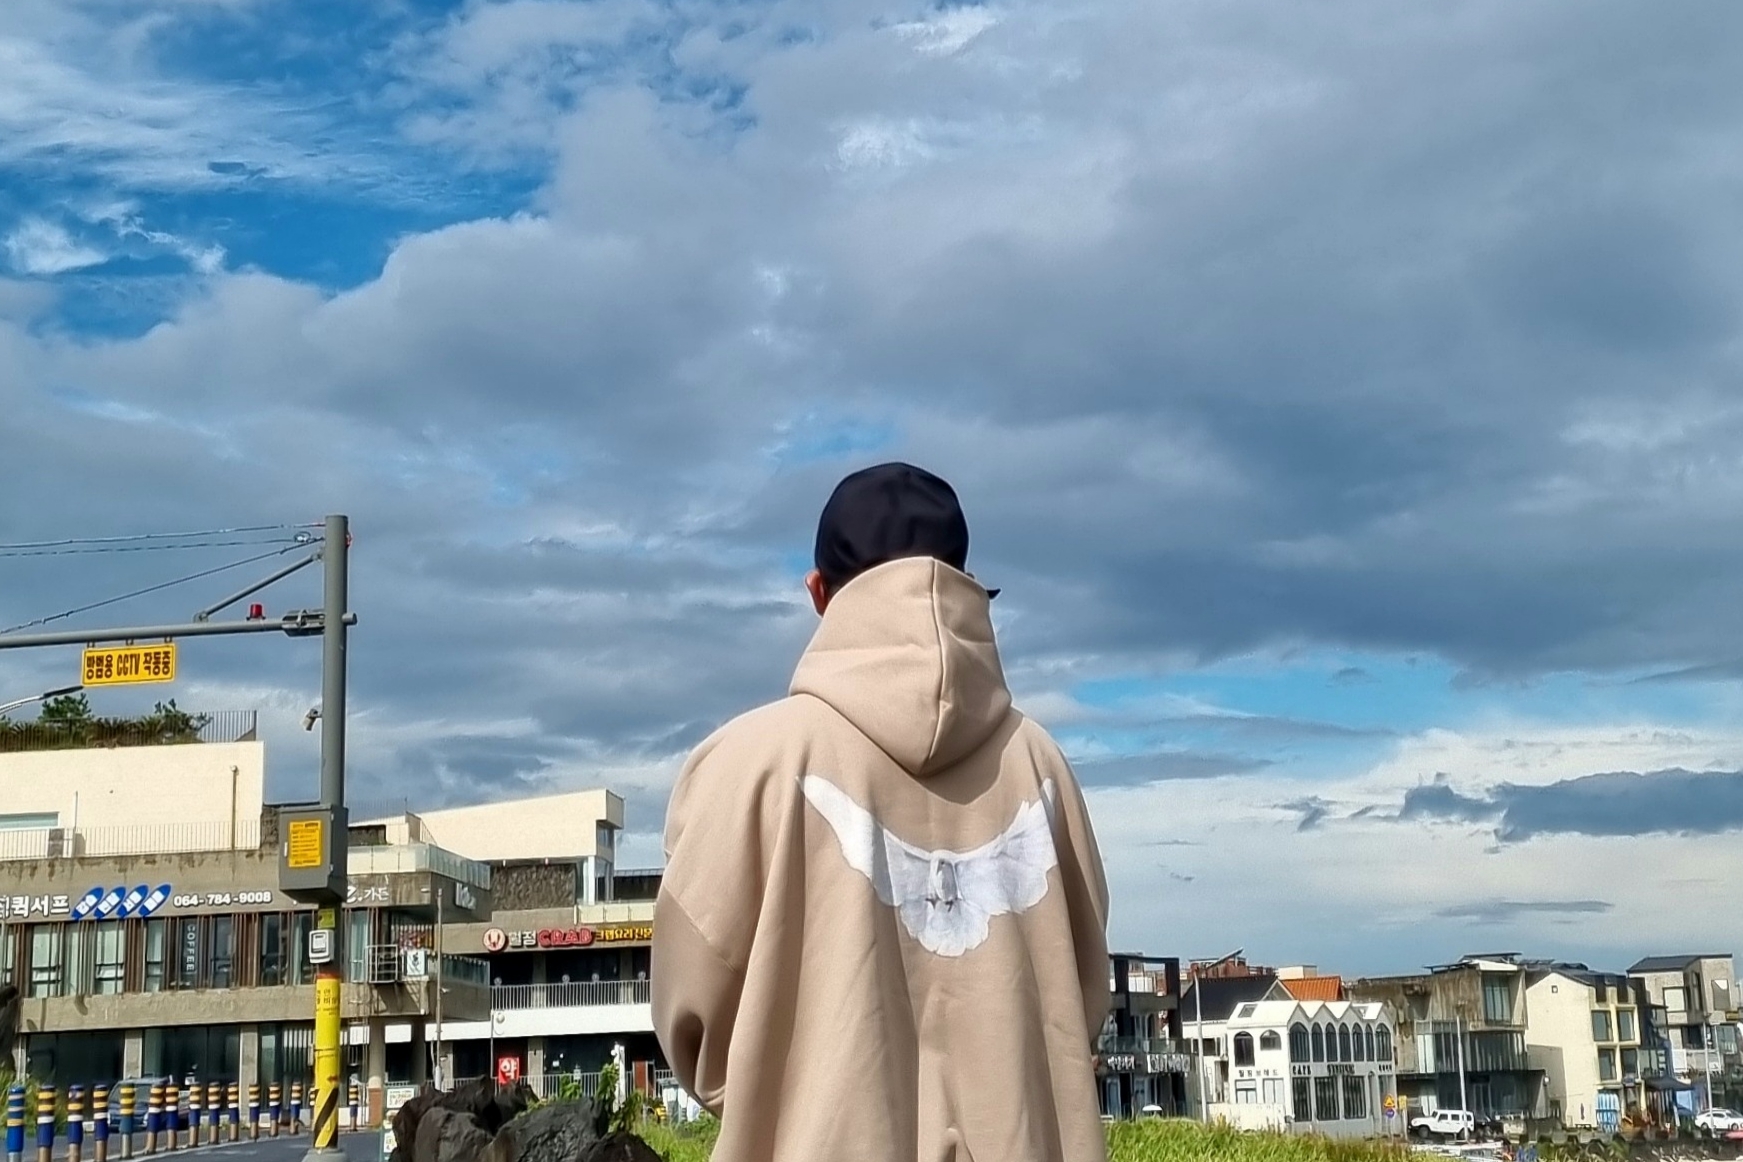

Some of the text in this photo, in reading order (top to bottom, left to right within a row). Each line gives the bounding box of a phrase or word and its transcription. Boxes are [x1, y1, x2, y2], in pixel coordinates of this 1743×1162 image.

[86, 650, 171, 680] 방범용 CCTV 작동중
[186, 924, 196, 972] COFFEE
